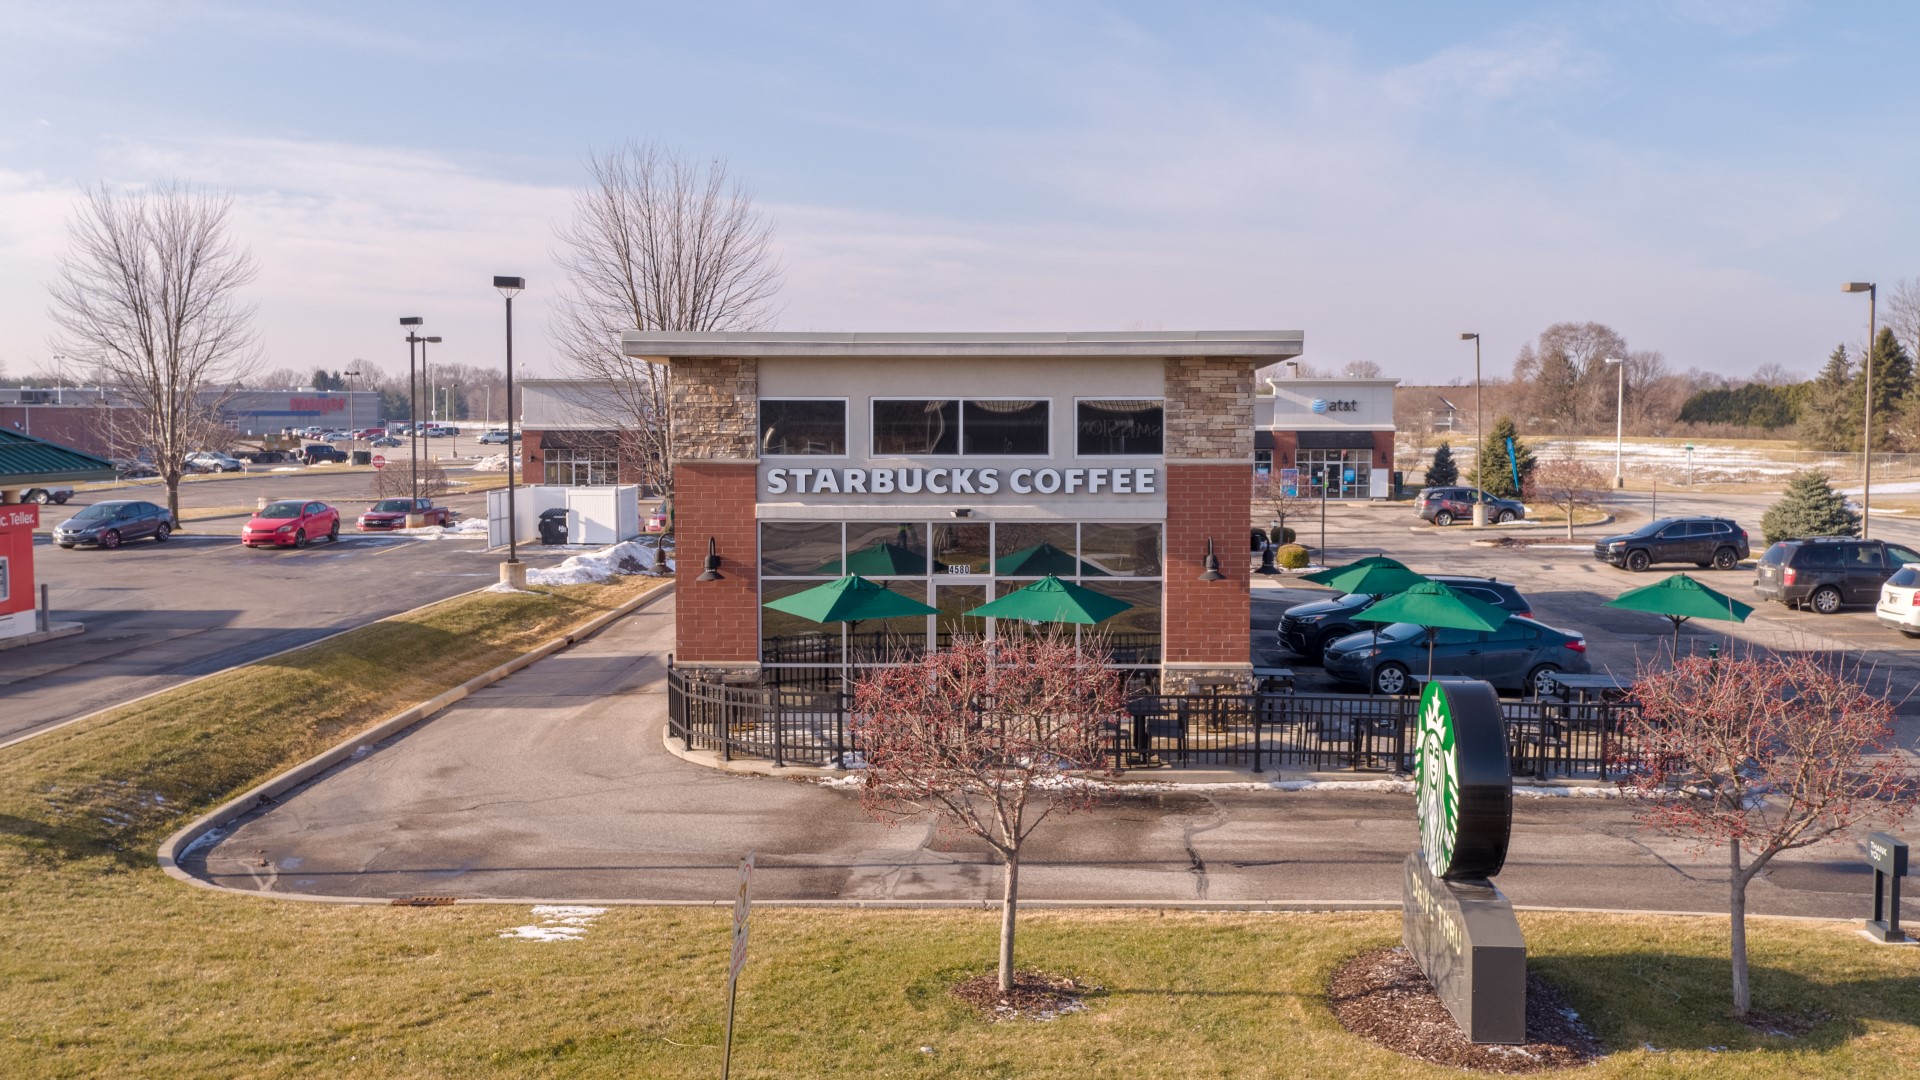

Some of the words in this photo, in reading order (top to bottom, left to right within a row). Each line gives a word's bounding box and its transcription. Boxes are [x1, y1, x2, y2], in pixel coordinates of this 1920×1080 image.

[1329, 400, 1357, 411] at&t
[766, 467, 999, 494] STARBUCKS
[1009, 467, 1156, 494] COFFEE
[9, 511, 35, 525] Teller.
[949, 565, 970, 574] 4580
[1870, 850, 1881, 861] YOU
[1437, 903, 1461, 956] THRU
